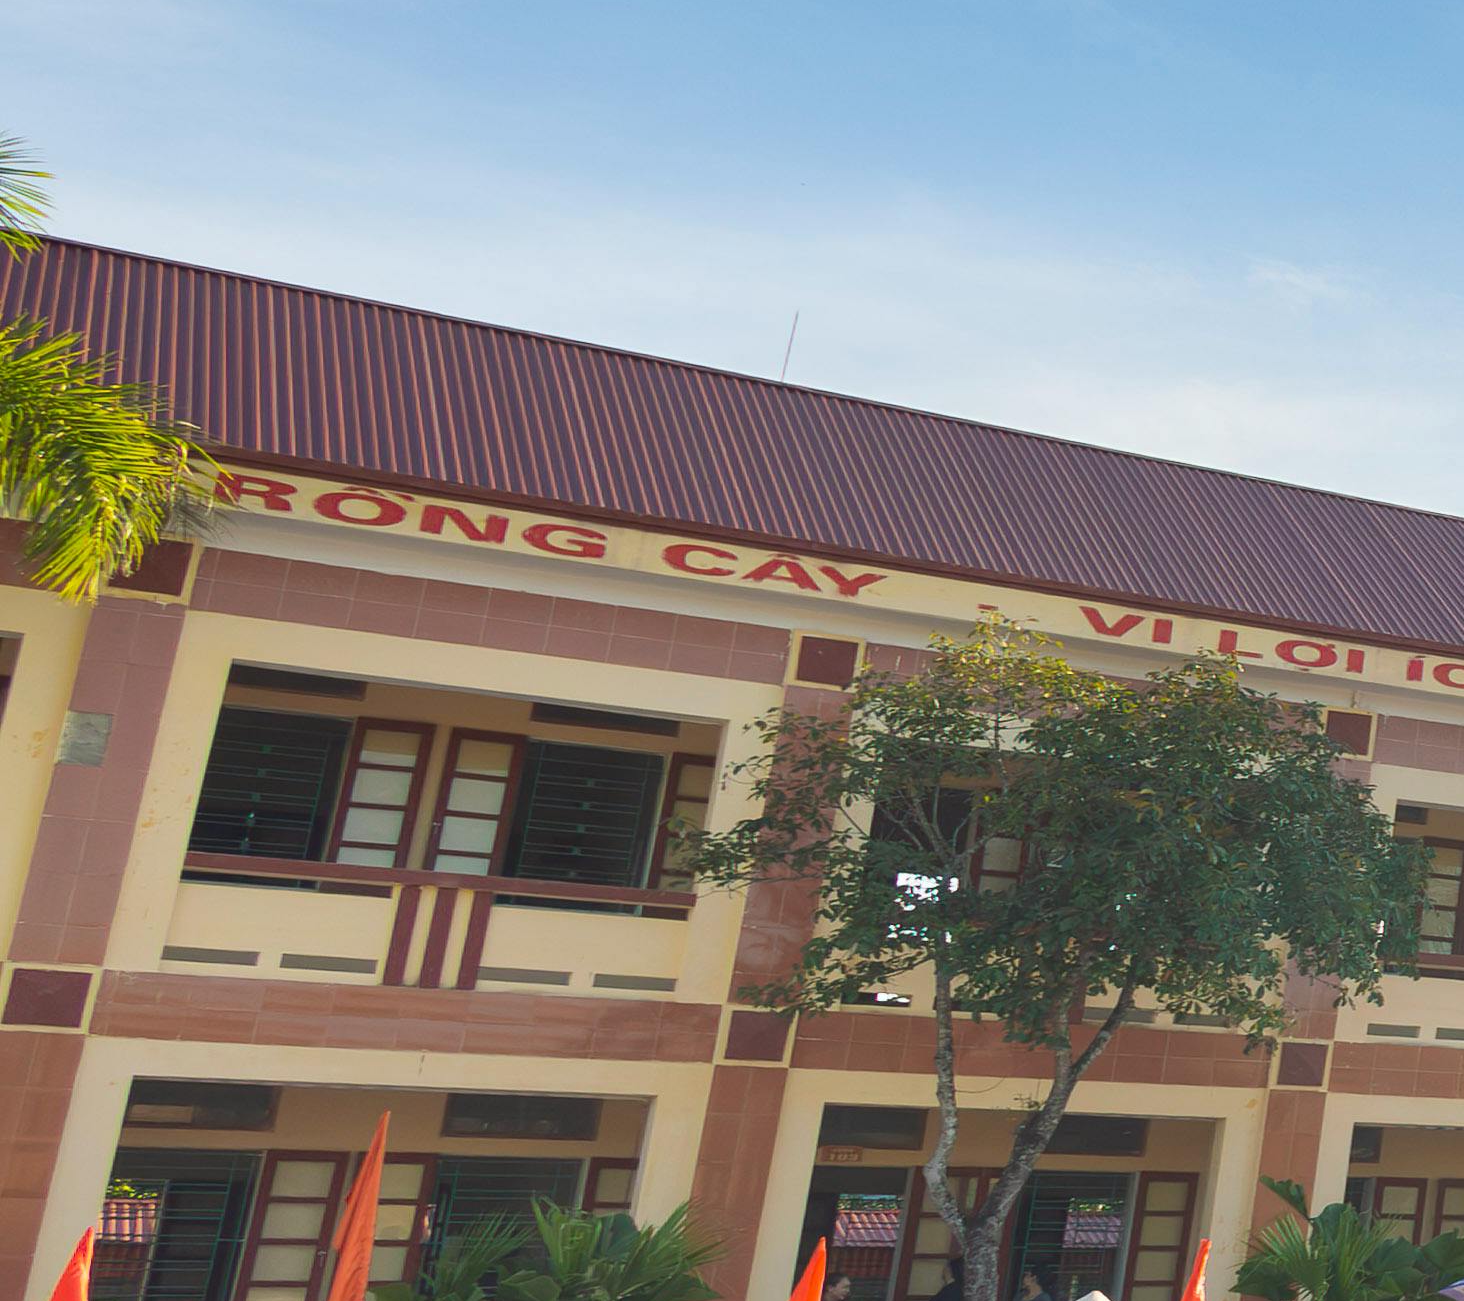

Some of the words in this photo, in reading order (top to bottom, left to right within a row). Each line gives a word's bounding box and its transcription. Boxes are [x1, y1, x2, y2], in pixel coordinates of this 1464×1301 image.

[186, 464, 607, 559] RỒNG
[662, 543, 888, 598] CÂY
[1217, 629, 1365, 674] LỢI
